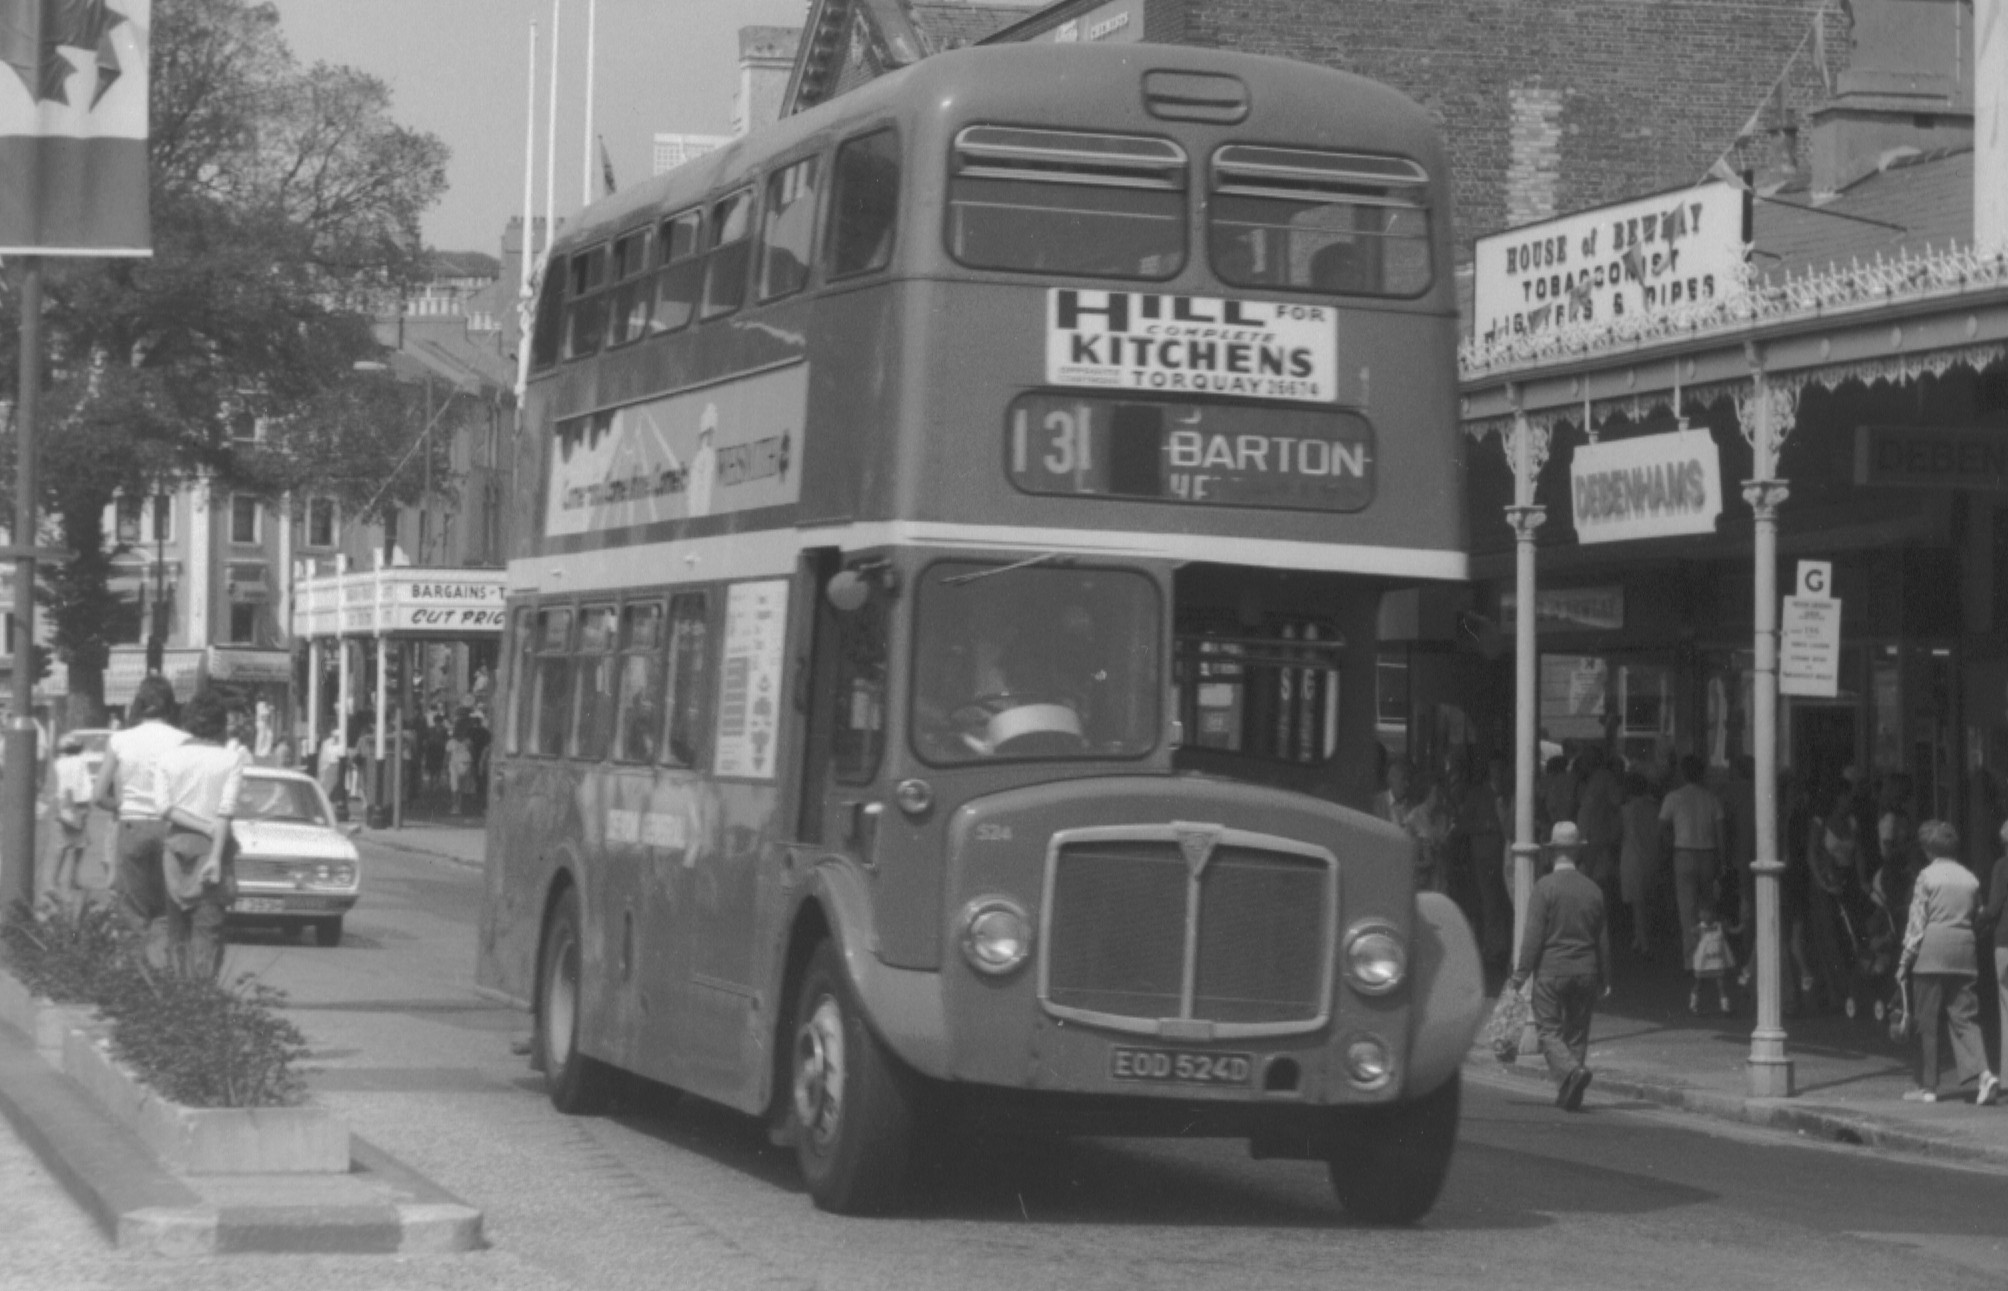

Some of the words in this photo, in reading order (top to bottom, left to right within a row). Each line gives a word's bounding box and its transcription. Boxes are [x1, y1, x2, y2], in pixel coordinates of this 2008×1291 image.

[1506, 235, 1567, 275] HOUSE
[1581, 227, 1597, 258] of
[1612, 202, 1703, 250] BEWY
[1057, 289, 1265, 332] HILL
[1276, 304, 1326, 323] FOR
[1145, 324, 1277, 343] COMPLETE
[1071, 334, 1313, 377] KITCHENS
[1132, 370, 1262, 394] TORQUAY
[1168, 430, 1365, 477] BARTON
[411, 584, 486, 600] BARGAINS
[1803, 568, 1825, 593] G
[411, 608, 456, 625] CUT
[1115, 1050, 1171, 1077] EOD
[1175, 1053, 1250, 1081] 524D
